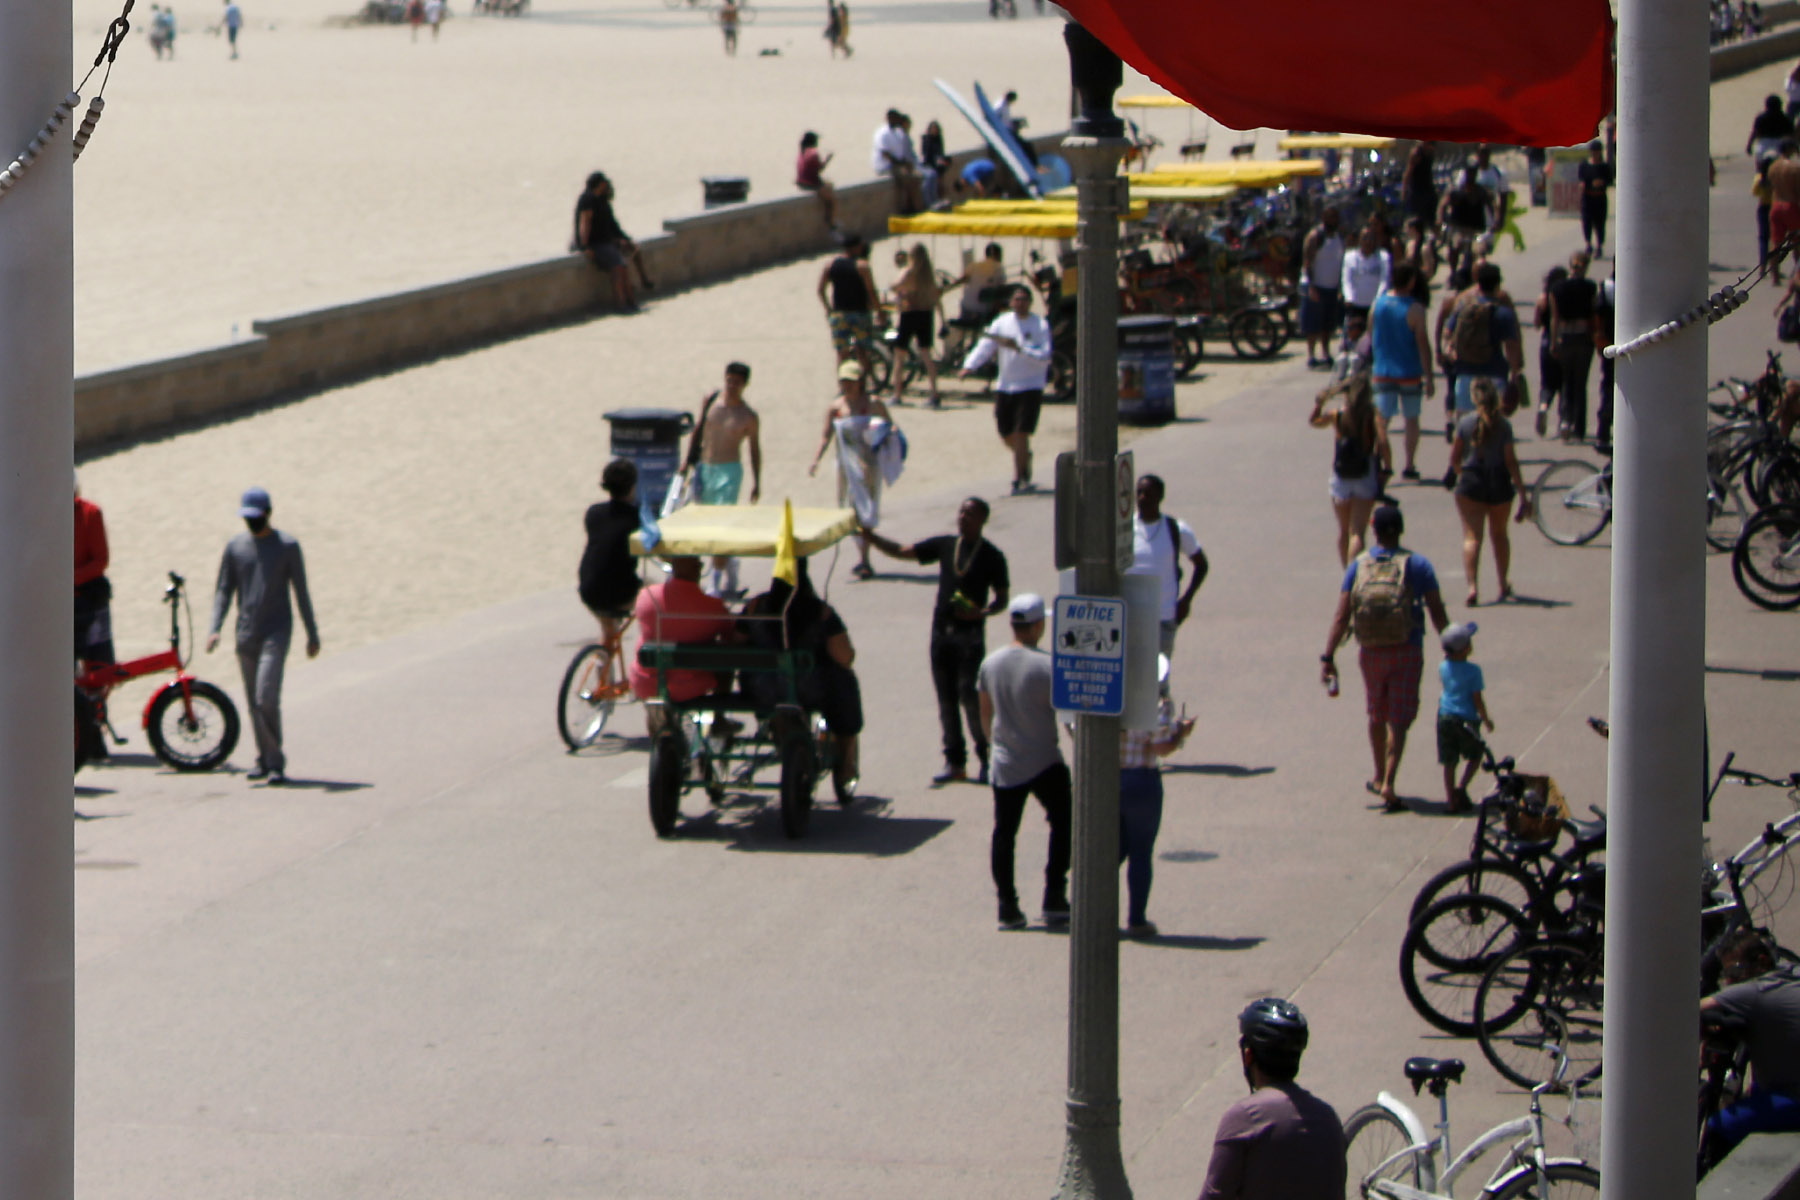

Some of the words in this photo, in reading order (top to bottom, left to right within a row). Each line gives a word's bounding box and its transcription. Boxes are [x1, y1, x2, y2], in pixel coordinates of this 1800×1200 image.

[1066, 604, 1115, 622] NOTICE
[1057, 658, 1072, 668] ALL
[1075, 659, 1120, 673] ACTIVITIES
[1064, 672, 1113, 683] MONITORED
[1068, 682, 1079, 692] BY
[1082, 683, 1108, 694] VIDEO
